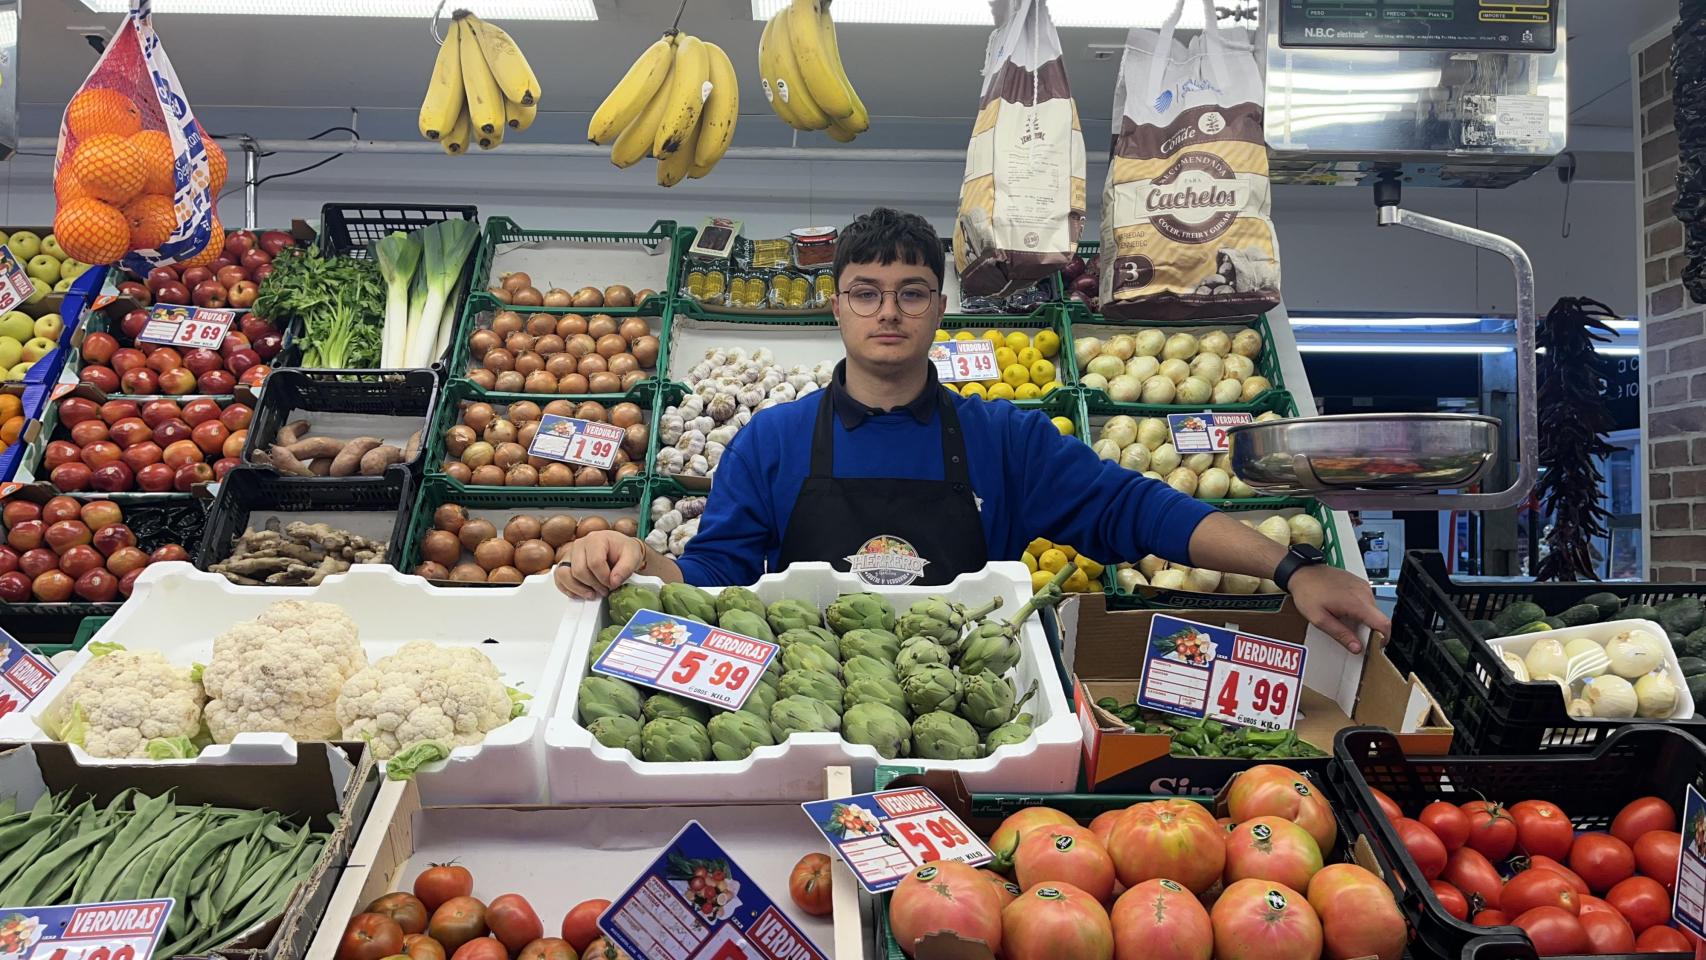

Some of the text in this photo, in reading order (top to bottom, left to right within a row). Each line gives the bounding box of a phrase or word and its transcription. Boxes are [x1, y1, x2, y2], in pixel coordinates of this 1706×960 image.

[1161, 129, 1196, 154] Conde
[1146, 185, 1237, 212] Cachelos
[1209, 212, 1232, 234] GUISAR
[1124, 261, 1139, 282] 3
[198, 311, 228, 322] FRUTAS
[958, 343, 990, 353] VERDURAS
[1215, 415, 1249, 425] VERDURAS
[586, 425, 620, 440] VERDURAS
[853, 554, 921, 571] HERRERO
[709, 633, 770, 660] VERDURAS
[1237, 640, 1299, 671] VERDURAS
[10, 658, 50, 693] VERDURAS
[879, 792, 937, 814] VERDURAS
[71, 907, 161, 934] VERDURAS
